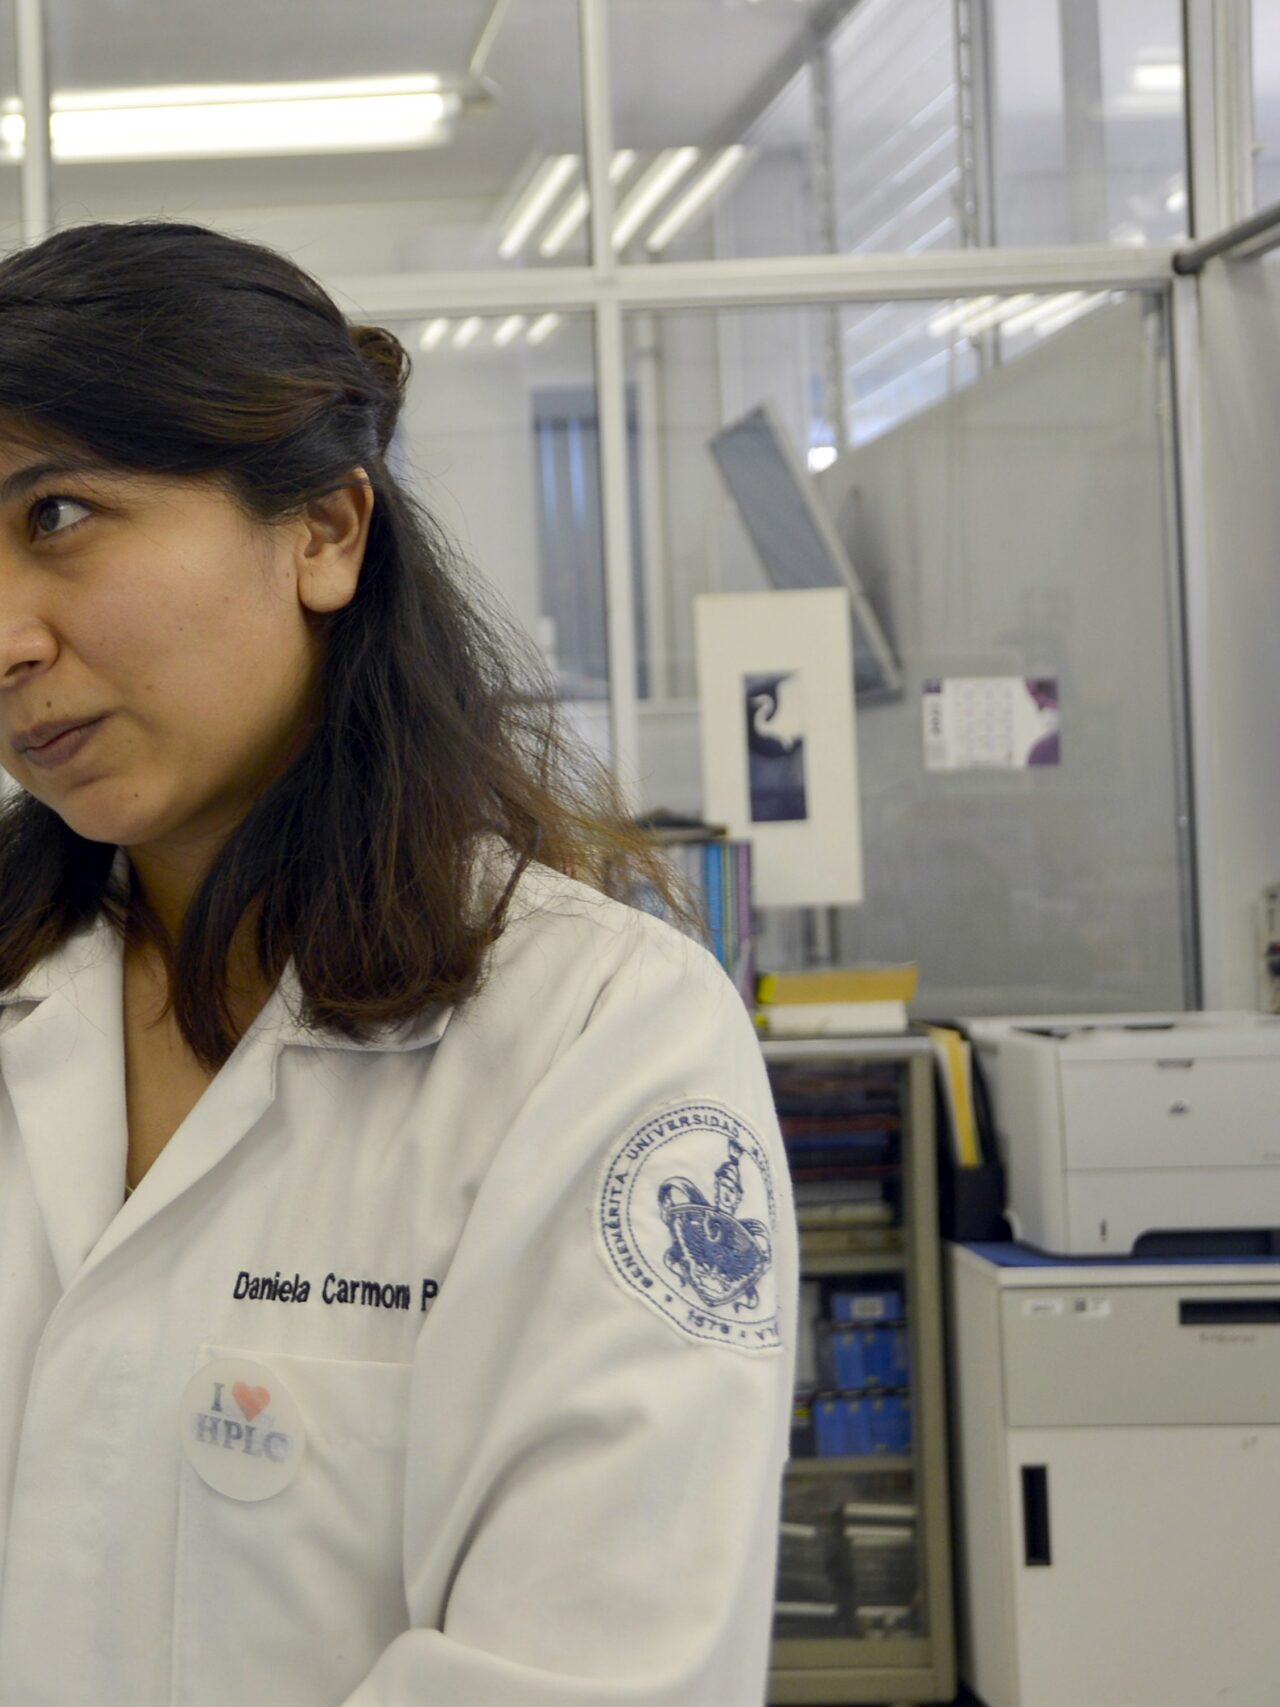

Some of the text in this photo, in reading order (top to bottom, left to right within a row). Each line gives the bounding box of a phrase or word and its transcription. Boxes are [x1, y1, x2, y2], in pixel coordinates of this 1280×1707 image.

[627, 1113, 740, 1161] UNIVERSIDAD
[233, 1271, 311, 1303] Daniela
[211, 1382, 225, 1412] I
[194, 1413, 291, 1463] HPLC
